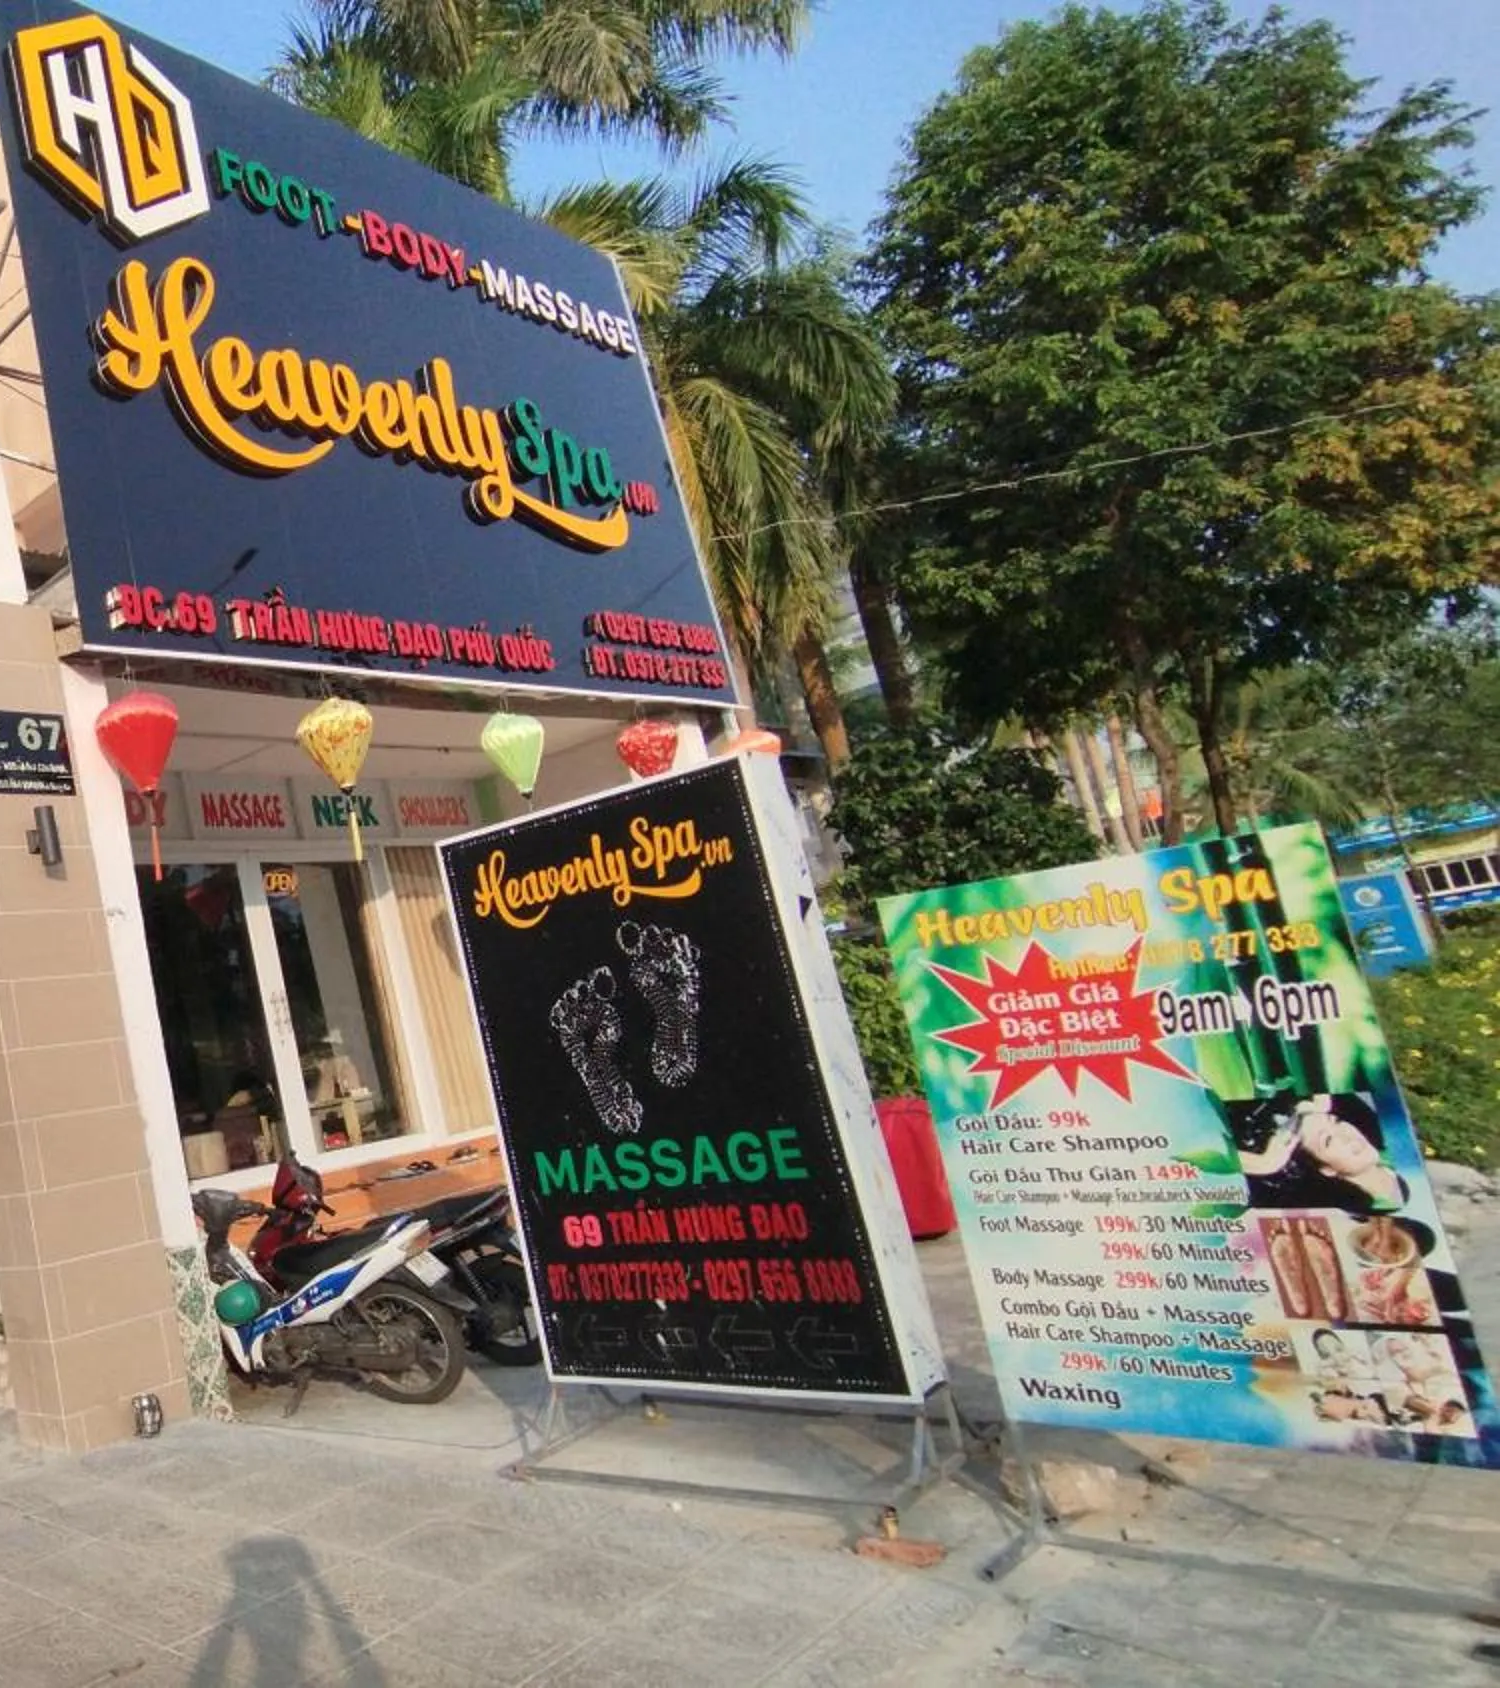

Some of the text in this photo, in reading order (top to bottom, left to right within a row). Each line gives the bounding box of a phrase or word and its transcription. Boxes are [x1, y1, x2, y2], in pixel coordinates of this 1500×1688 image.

[94, 256, 514, 522] Heavenly
[17, 717, 60, 751] 67
[201, 792, 286, 829] MASSAGE
[474, 834, 632, 929] Heavenly
[915, 866, 1276, 949] Heavenly Spa
[1210, 929, 1258, 961] 277
[1265, 921, 1319, 954] 333
[988, 980, 1120, 1014] Giảm Giá
[1156, 976, 1340, 1037] 9am 6pm
[1060, 1007, 1122, 1035] Biệt
[1048, 1111, 1091, 1128] 99k
[534, 1127, 809, 1196] MASSAGE
[960, 1134, 1169, 1155] Hair Care Shampoo
[1144, 1164, 1198, 1181] 149k
[563, 1214, 603, 1248] 69
[980, 1216, 1012, 1233] Foot
[1016, 1215, 1084, 1236] Massage
[1171, 1216, 1247, 1233] Minutes
[1179, 1243, 1254, 1263] Minutes
[991, 1267, 1030, 1291] Body
[1033, 1268, 1105, 1292] Massage
[1193, 1272, 1271, 1295] Minutes
[1000, 1297, 1061, 1318] Combo
[1163, 1303, 1254, 1328] Massage
[1006, 1321, 1041, 1340] Hair
[1046, 1323, 1086, 1343] Care
[1090, 1326, 1174, 1350] Shampoo
[1198, 1331, 1288, 1357] Massage
[1149, 1358, 1233, 1382] Minutes
[1018, 1376, 1122, 1410] Waxing
